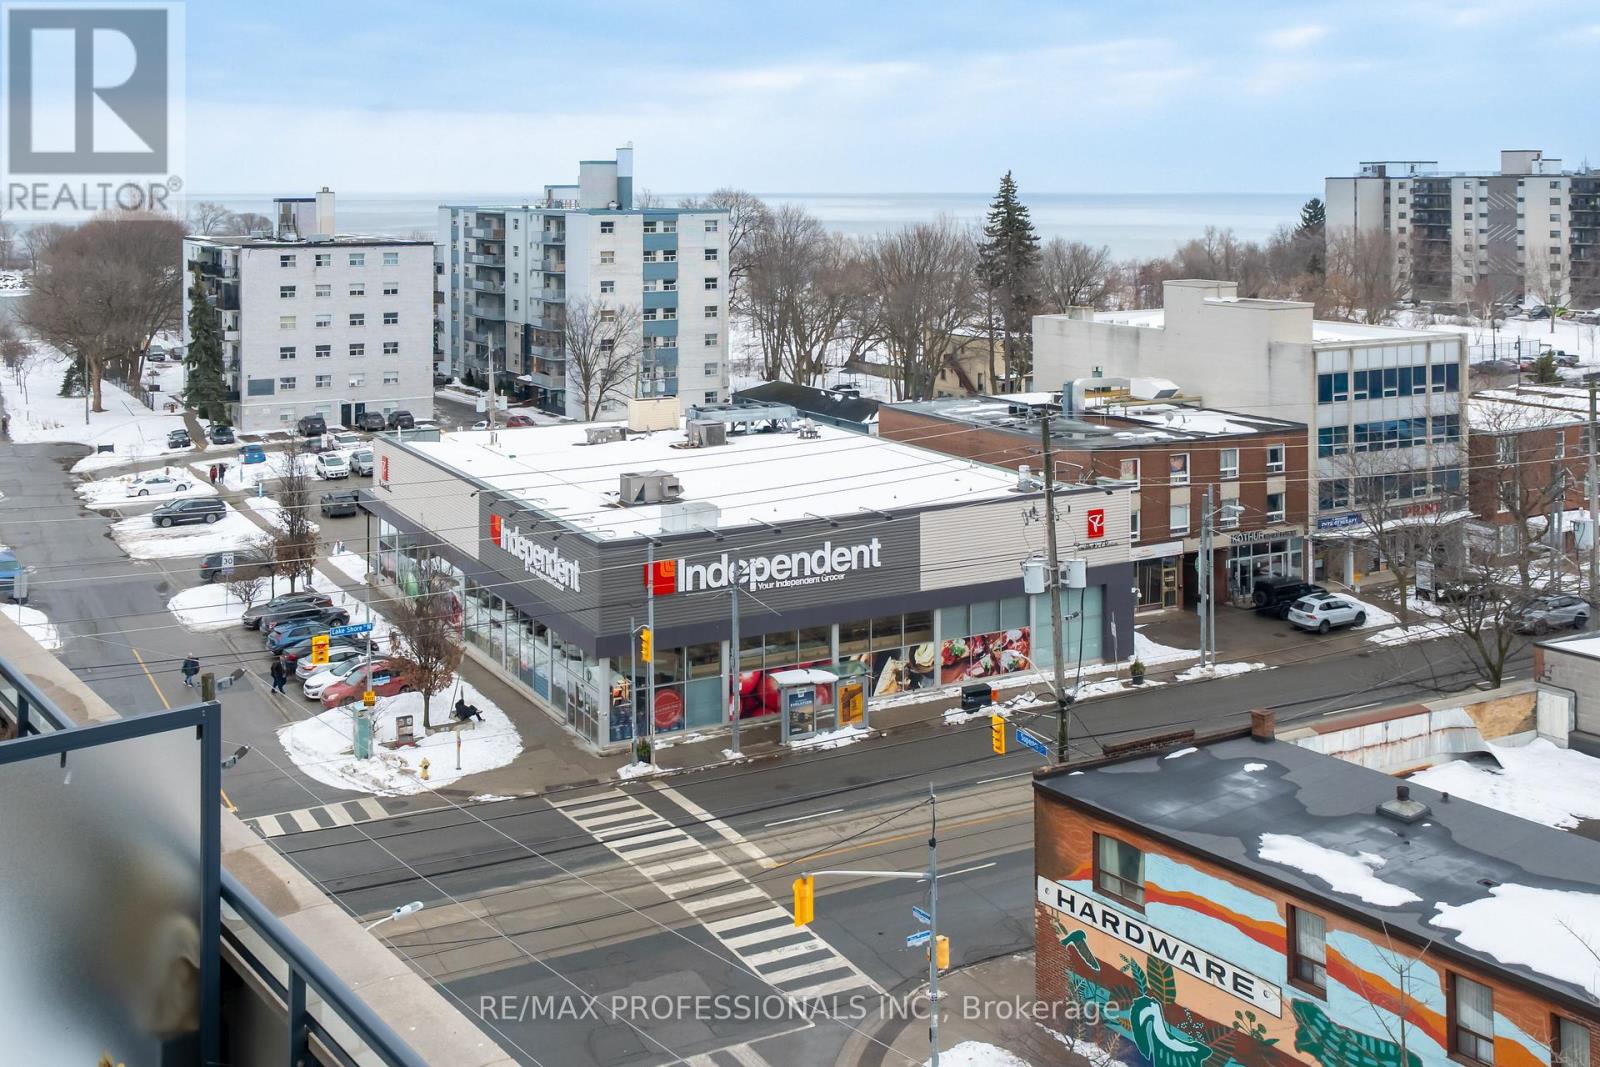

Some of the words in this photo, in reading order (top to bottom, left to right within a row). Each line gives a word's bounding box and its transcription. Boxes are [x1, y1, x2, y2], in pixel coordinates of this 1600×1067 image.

[1404, 502, 1441, 517] PRINT
[224, 557, 233, 565] 30
[500, 518, 580, 593] Independent
[677, 538, 882, 592] Independent
[757, 582, 775, 590] Your
[775, 576, 820, 588] Independent
[821, 573, 846, 582] Grocer
[331, 628, 345, 636] Lake
[1057, 889, 1255, 1000] HARDWARE
